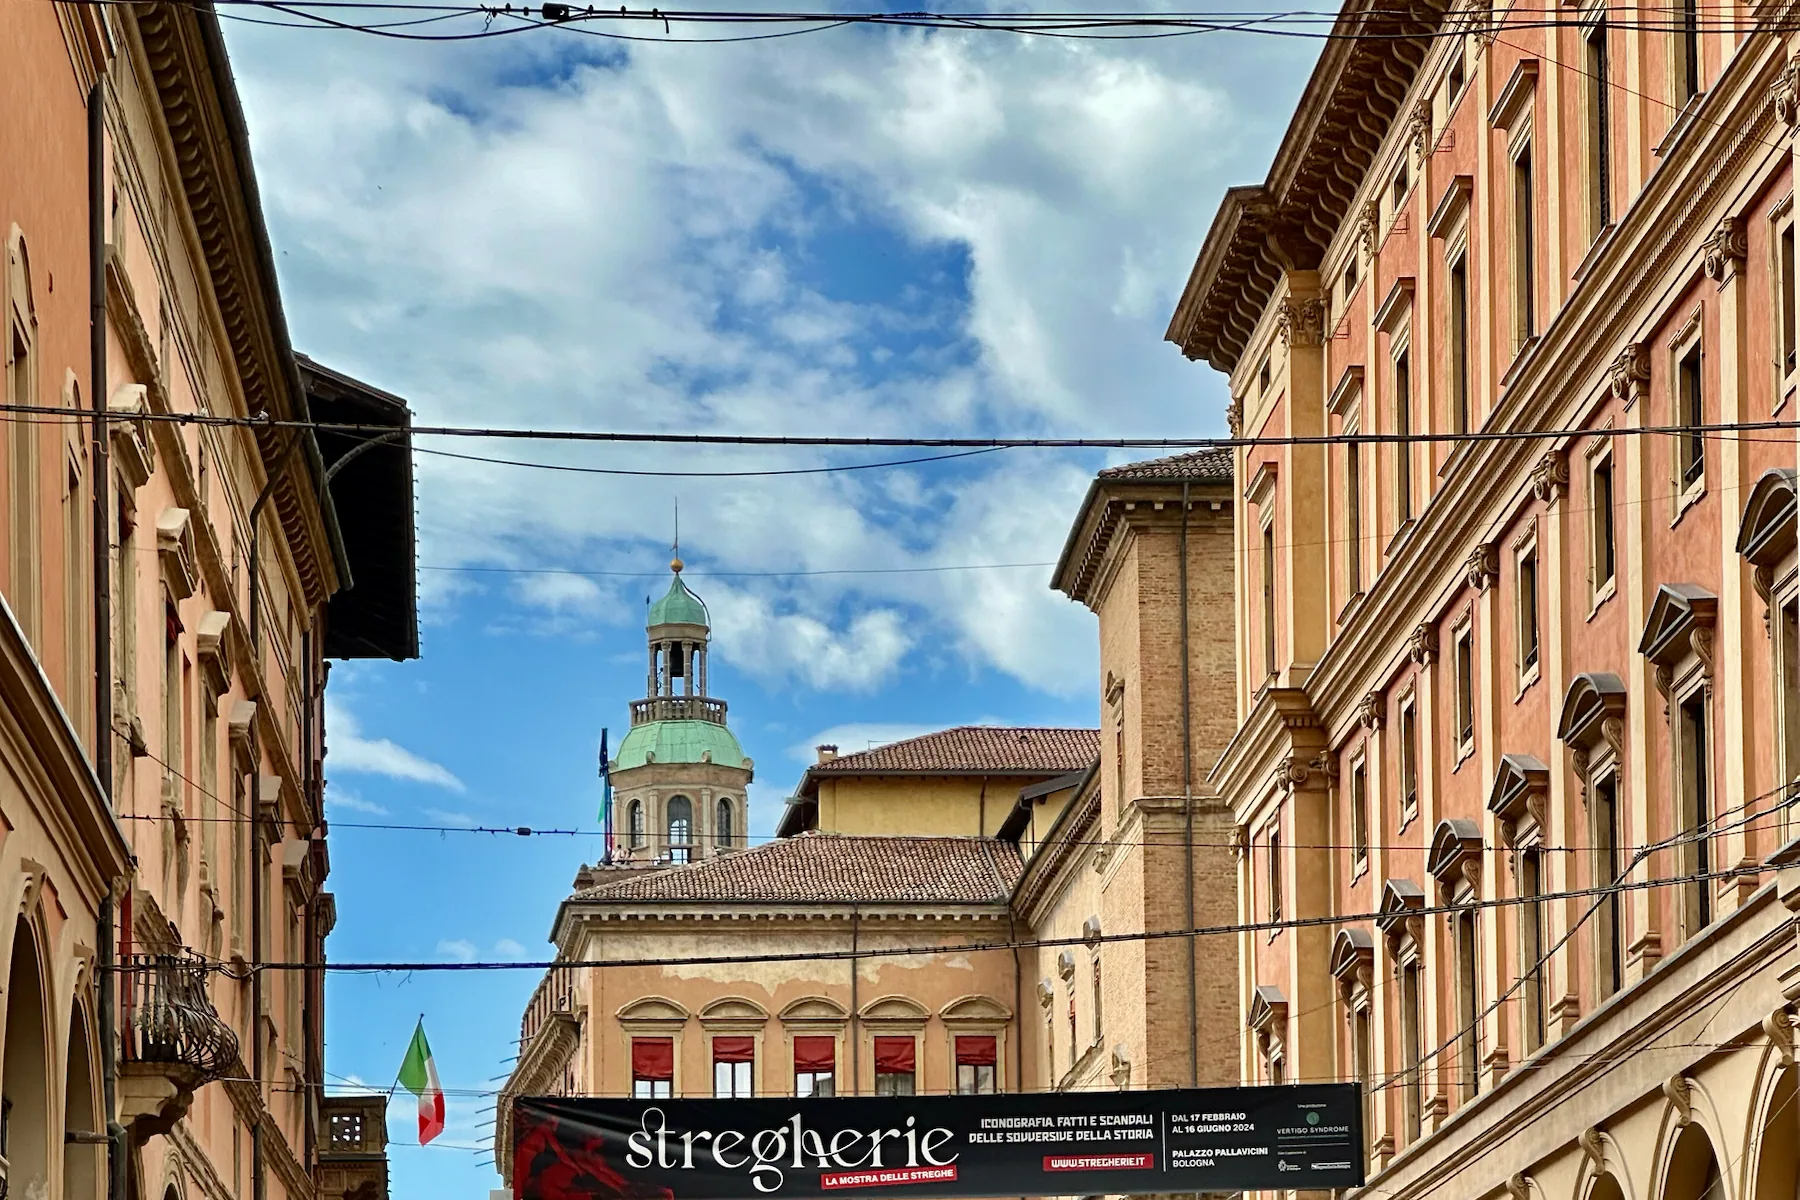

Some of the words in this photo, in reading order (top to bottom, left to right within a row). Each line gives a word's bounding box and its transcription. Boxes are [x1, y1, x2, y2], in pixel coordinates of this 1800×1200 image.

[1057, 1116, 1087, 1127] FATTI
[1090, 1116, 1097, 1126] E
[1099, 1114, 1153, 1126] SCANDALI
[1171, 1114, 1189, 1123] DAL
[1190, 1114, 1200, 1122] 17
[1201, 1112, 1247, 1122] FEBBRAIO
[1171, 1125, 1184, 1134] AL
[1184, 1125, 1196, 1133] 16
[1196, 1124, 1232, 1133] GIUGNO
[1232, 1123, 1255, 1132] 2024
[1276, 1127, 1309, 1135] VERTIGO
[1309, 1125, 1349, 1134] SYNDROME
[969, 1132, 1004, 1144] DELLE
[1005, 1130, 1074, 1143] SOVVERSIVE
[1075, 1129, 1112, 1141] DELLA
[1113, 1128, 1154, 1140] STORIA
[626, 1107, 959, 1193] stregherie
[1172, 1149, 1214, 1158] PALAZZO
[1214, 1147, 1269, 1157] PALLAVICINI
[1051, 1156, 1146, 1169] WWW.STREGHERIE.IT
[1172, 1159, 1216, 1168] BOLOGNA
[825, 1177, 838, 1186] LA
[839, 1174, 878, 1185] MOSTRA
[879, 1172, 909, 1182] DELLE
[909, 1168, 954, 1180] STREGHE
